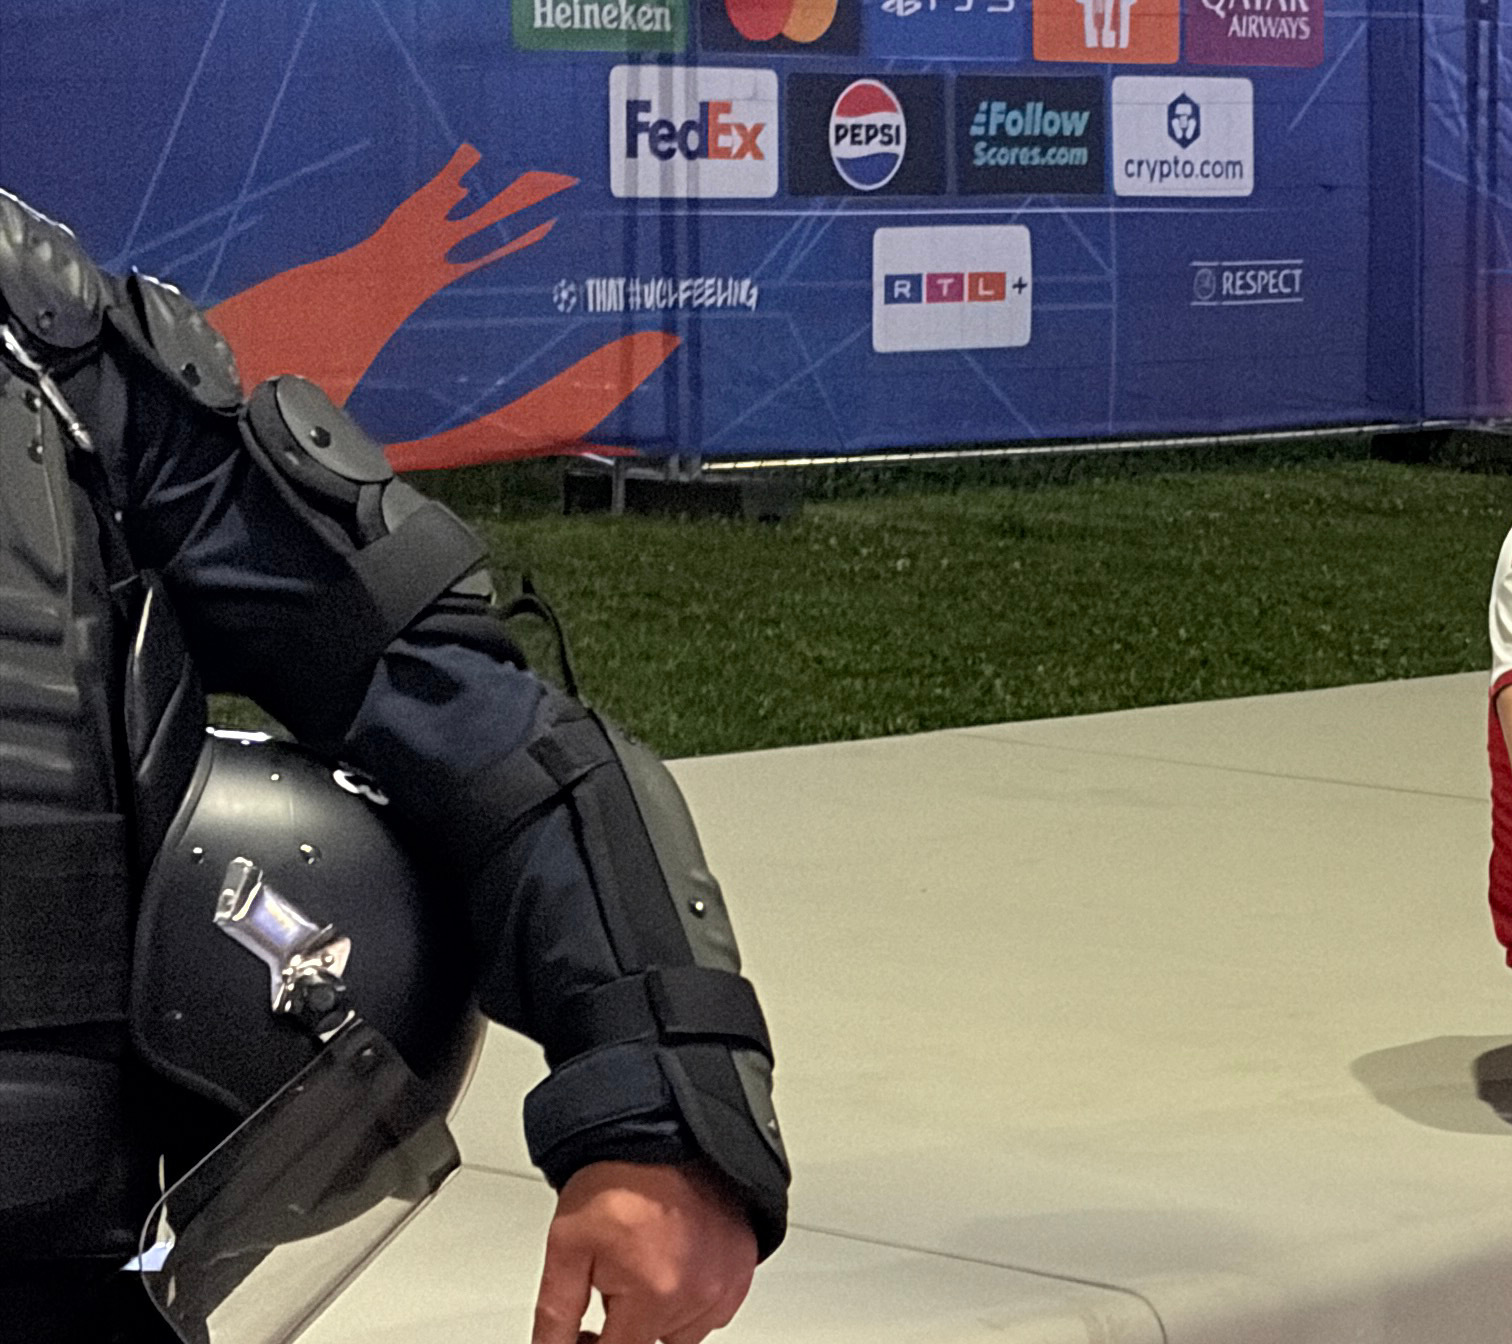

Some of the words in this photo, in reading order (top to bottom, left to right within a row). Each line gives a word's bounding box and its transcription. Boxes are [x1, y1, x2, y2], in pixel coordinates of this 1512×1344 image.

[1227, 15, 1310, 40] AIRWAYS
[625, 99, 766, 161] FedEx
[987, 101, 1091, 137] Follow
[833, 123, 900, 146] PEPSI
[973, 141, 1089, 167] Scores.com
[1124, 156, 1244, 183] crypto.com
[586, 277, 626, 312] THAT
[1222, 269, 1303, 295] RESPECT
